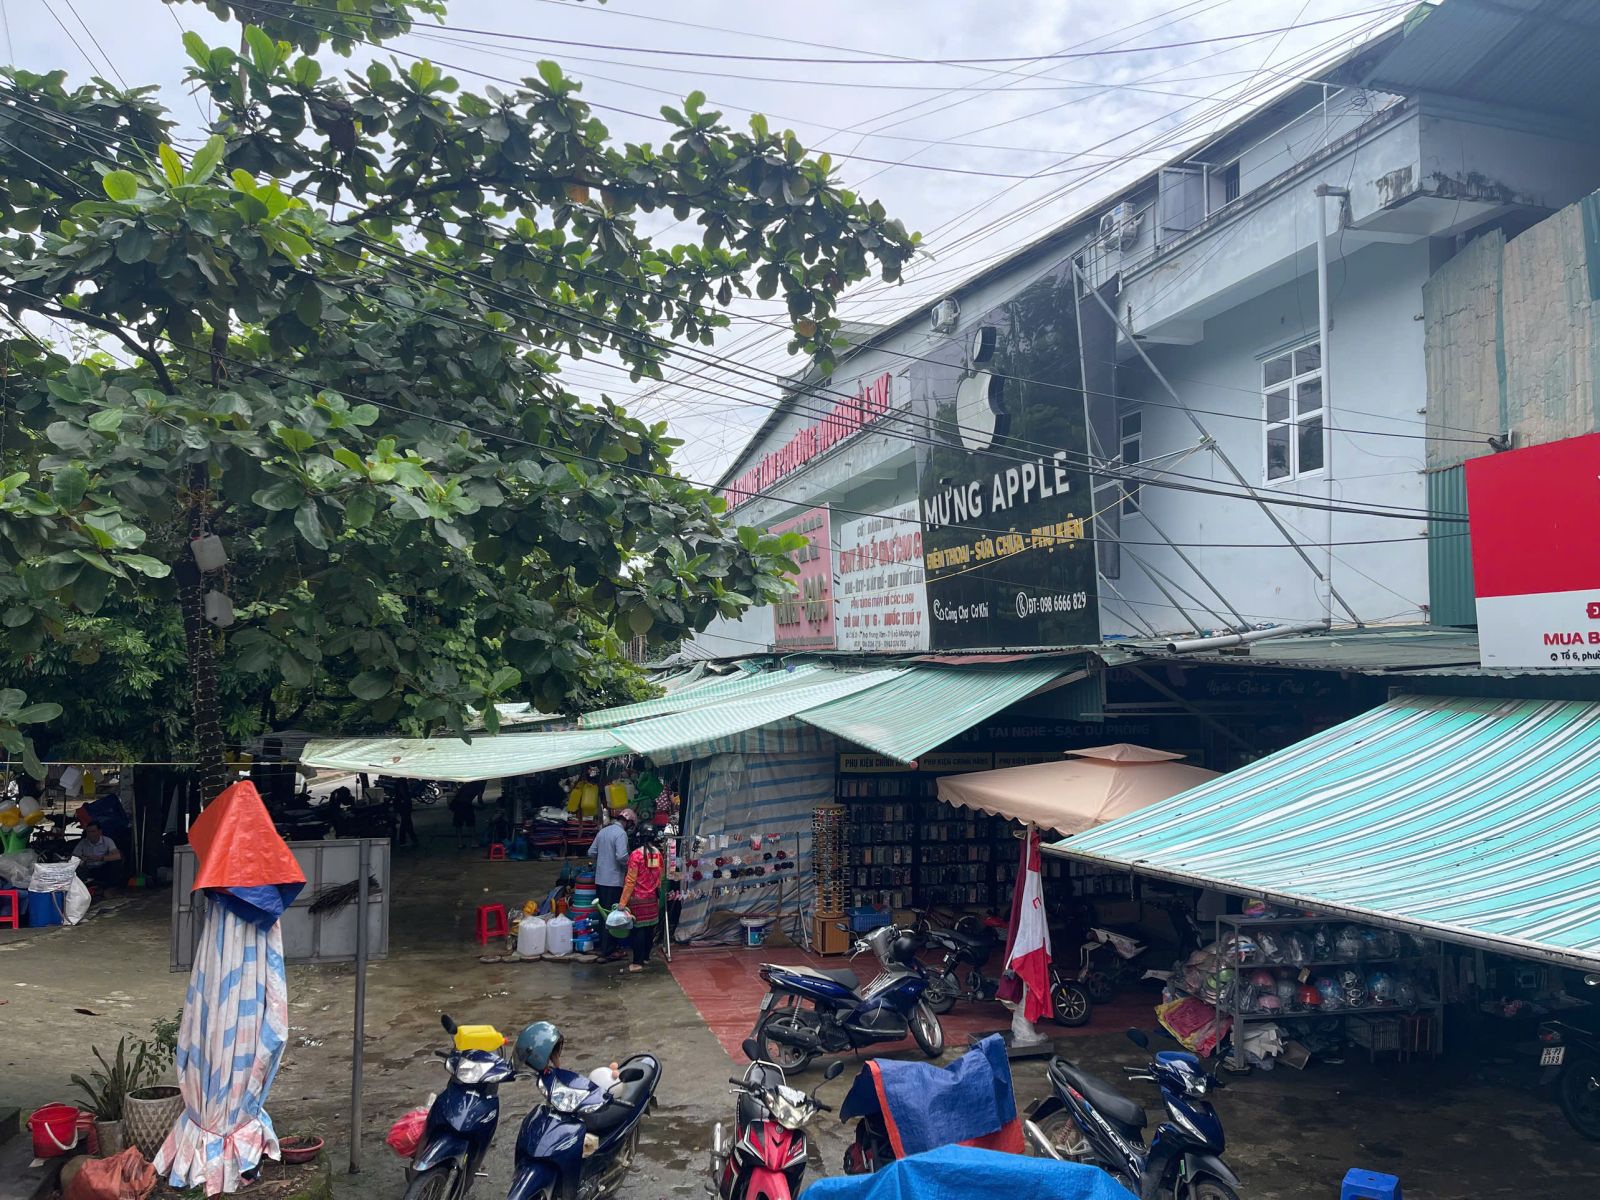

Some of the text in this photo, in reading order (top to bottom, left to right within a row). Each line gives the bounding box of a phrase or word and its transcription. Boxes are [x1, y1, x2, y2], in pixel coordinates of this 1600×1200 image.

[992, 451, 1070, 513] APPLE
[1040, 596, 1052, 613] 098
[1054, 594, 1071, 611] 6666
[1073, 591, 1087, 610] 829
[1543, 632, 1584, 645] MUA
